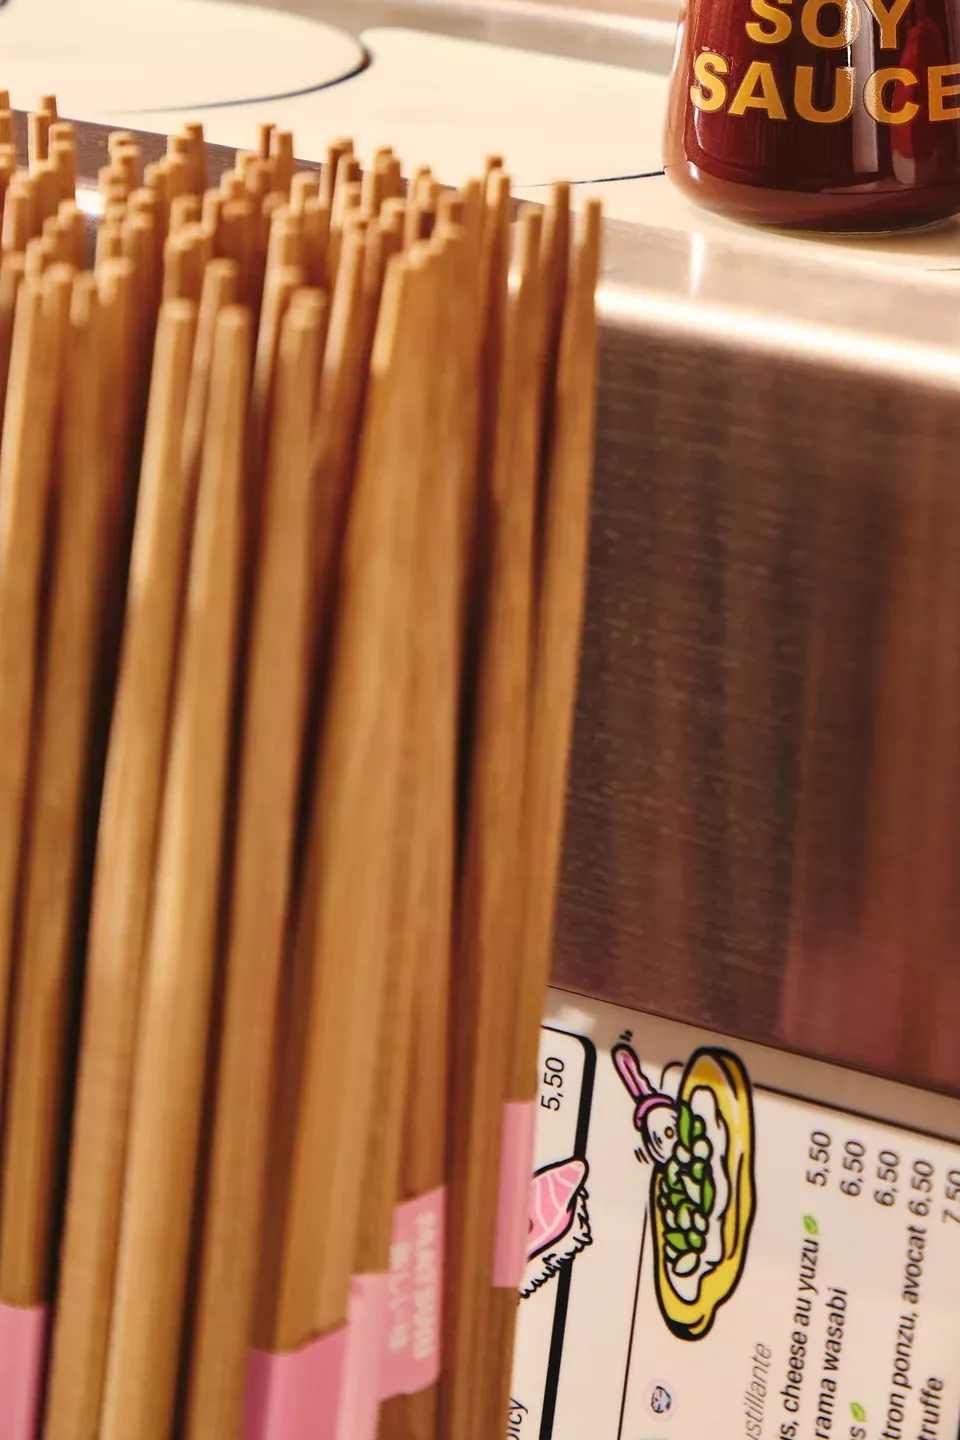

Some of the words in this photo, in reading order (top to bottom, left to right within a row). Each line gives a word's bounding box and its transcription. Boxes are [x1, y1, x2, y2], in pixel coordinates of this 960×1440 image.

[540, 1056, 566, 1112] 5,50
[806, 1131, 832, 1188] 5,50
[873, 1150, 900, 1207] 6,50
[908, 1159, 935, 1217] 6,50
[798, 1238, 820, 1295] yuzu
[823, 1286, 849, 1372] wasabi
[839, 1140, 866, 1197] 6,50
[902, 1224, 928, 1305] avocat
[794, 1296, 812, 1327] au
[780, 1330, 808, 1414] cheese
[892, 1311, 919, 1390] ponzu,
[880, 1392, 907, 1440] tron
